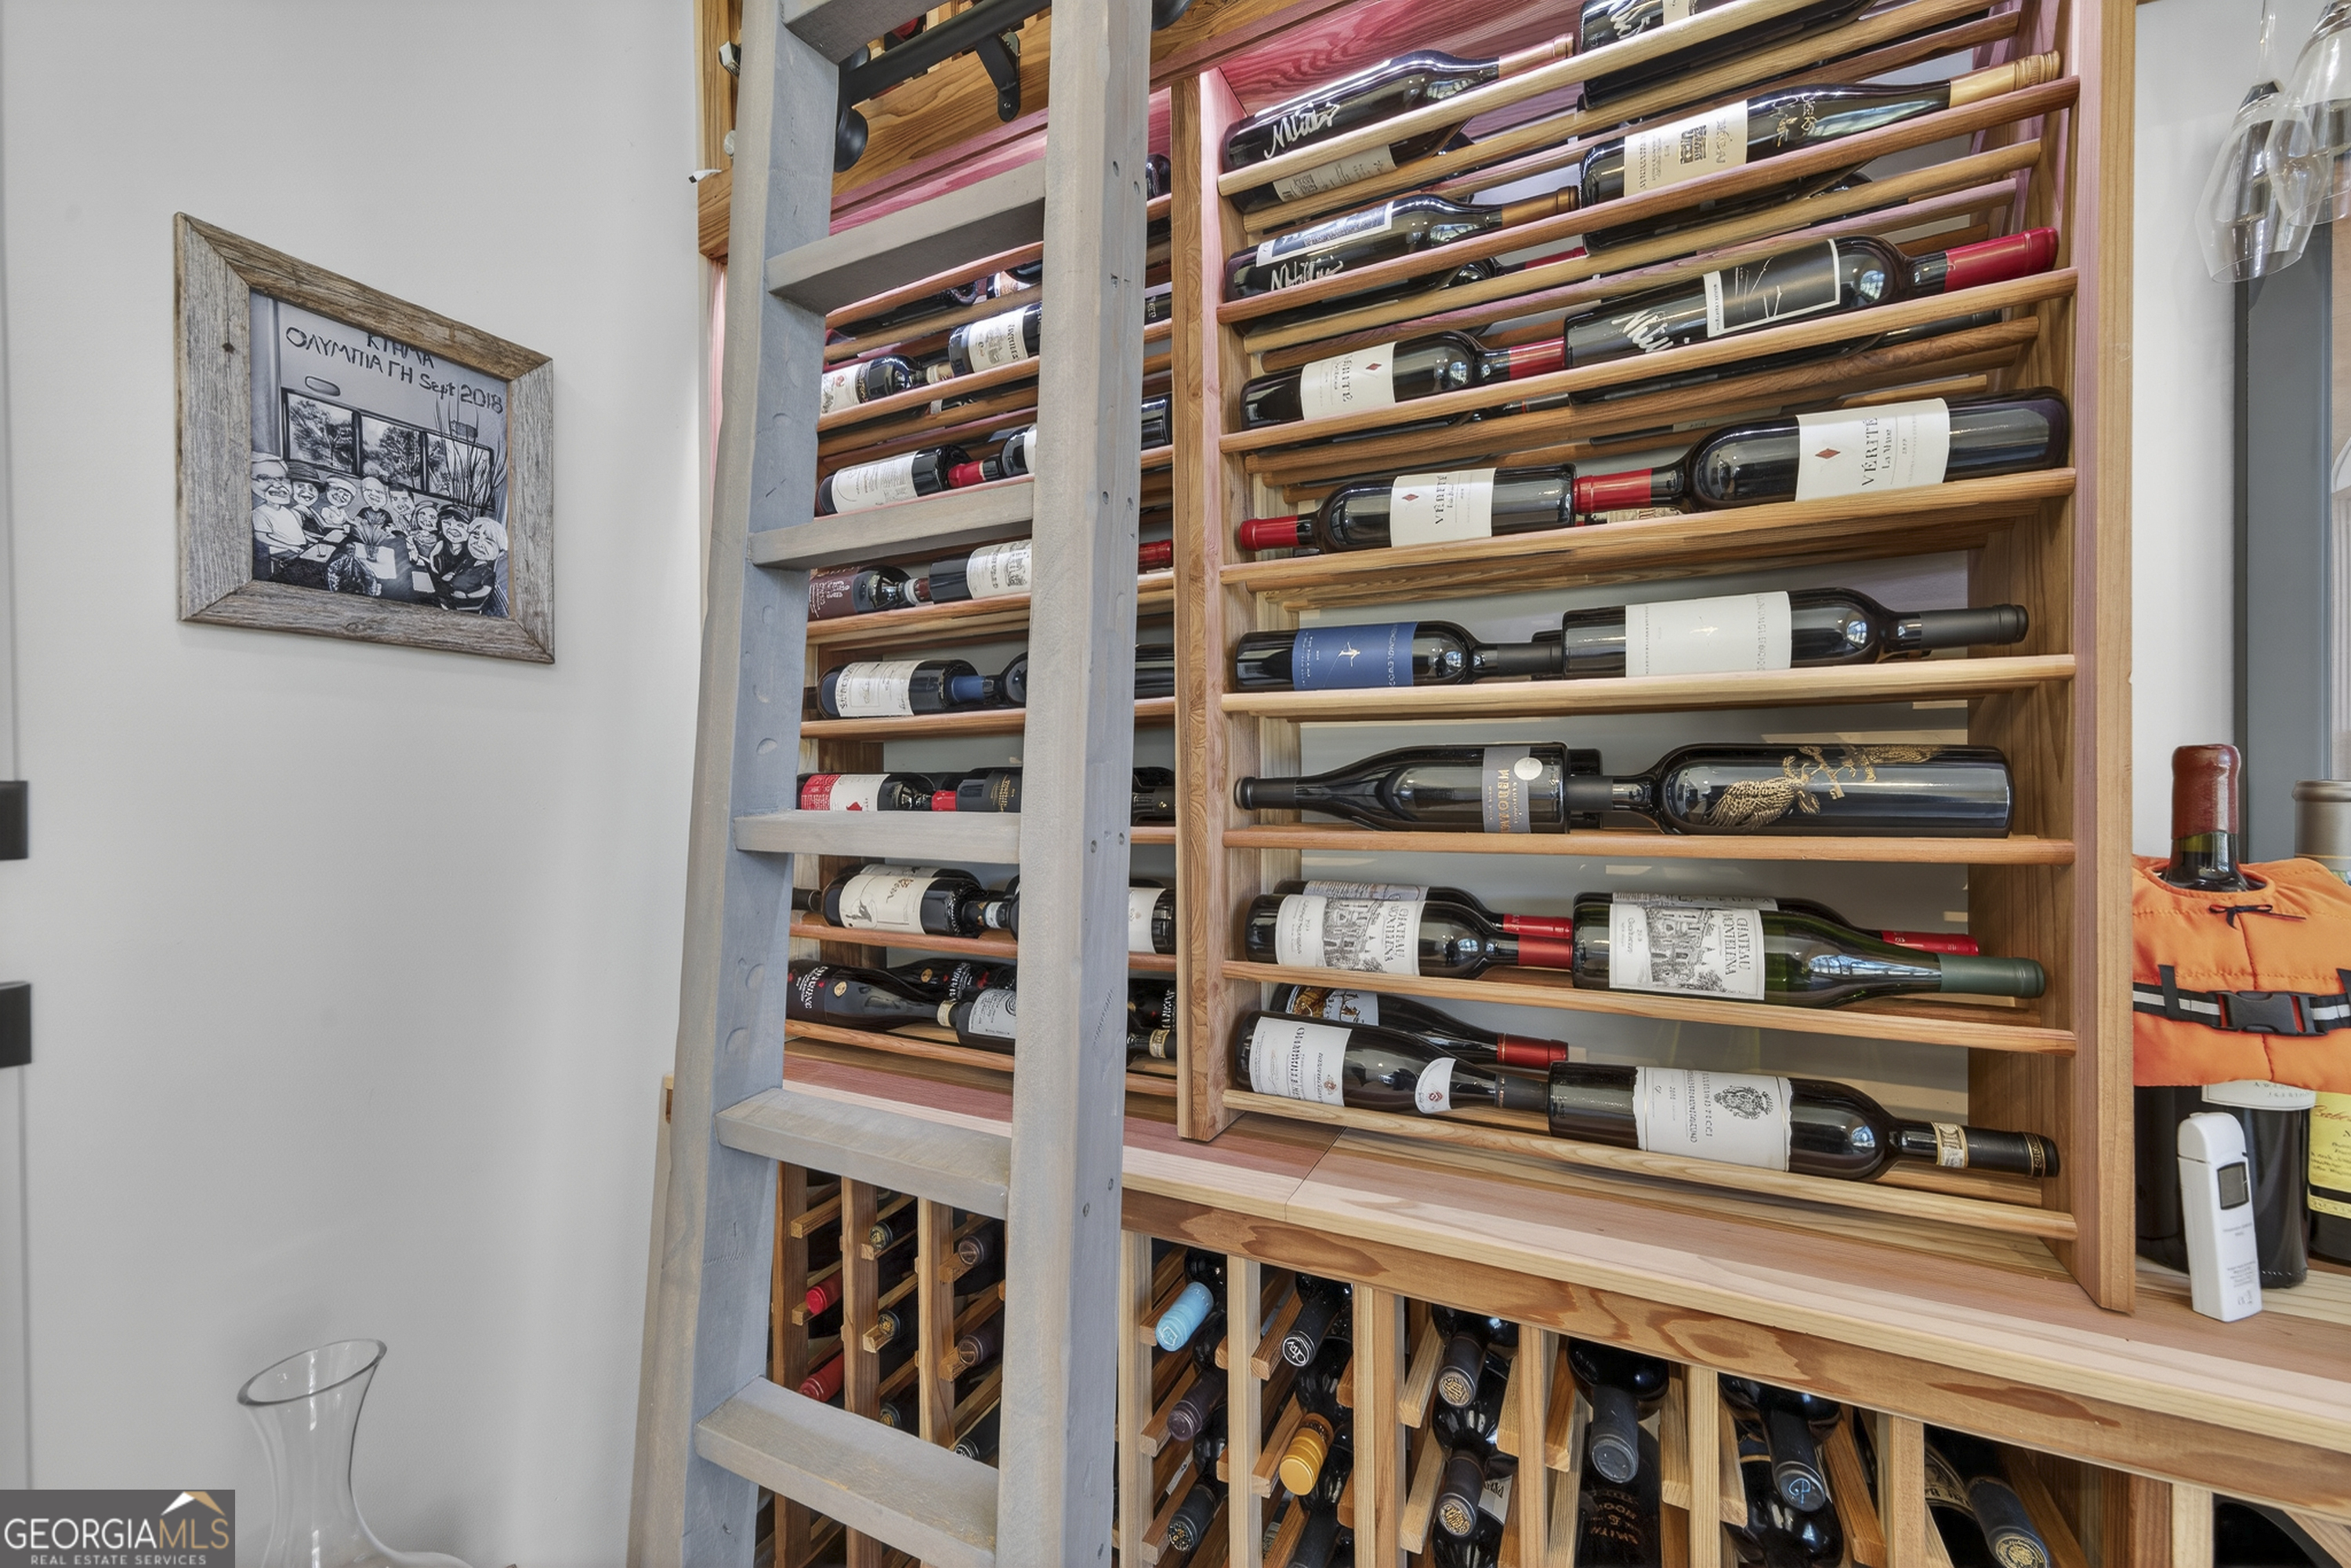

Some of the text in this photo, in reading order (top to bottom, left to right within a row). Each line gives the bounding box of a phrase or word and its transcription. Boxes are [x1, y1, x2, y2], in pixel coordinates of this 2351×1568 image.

[418, 373, 456, 400] Sept
[460, 384, 503, 415] 2018
[1861, 418, 1878, 486] VÉRITÉ
